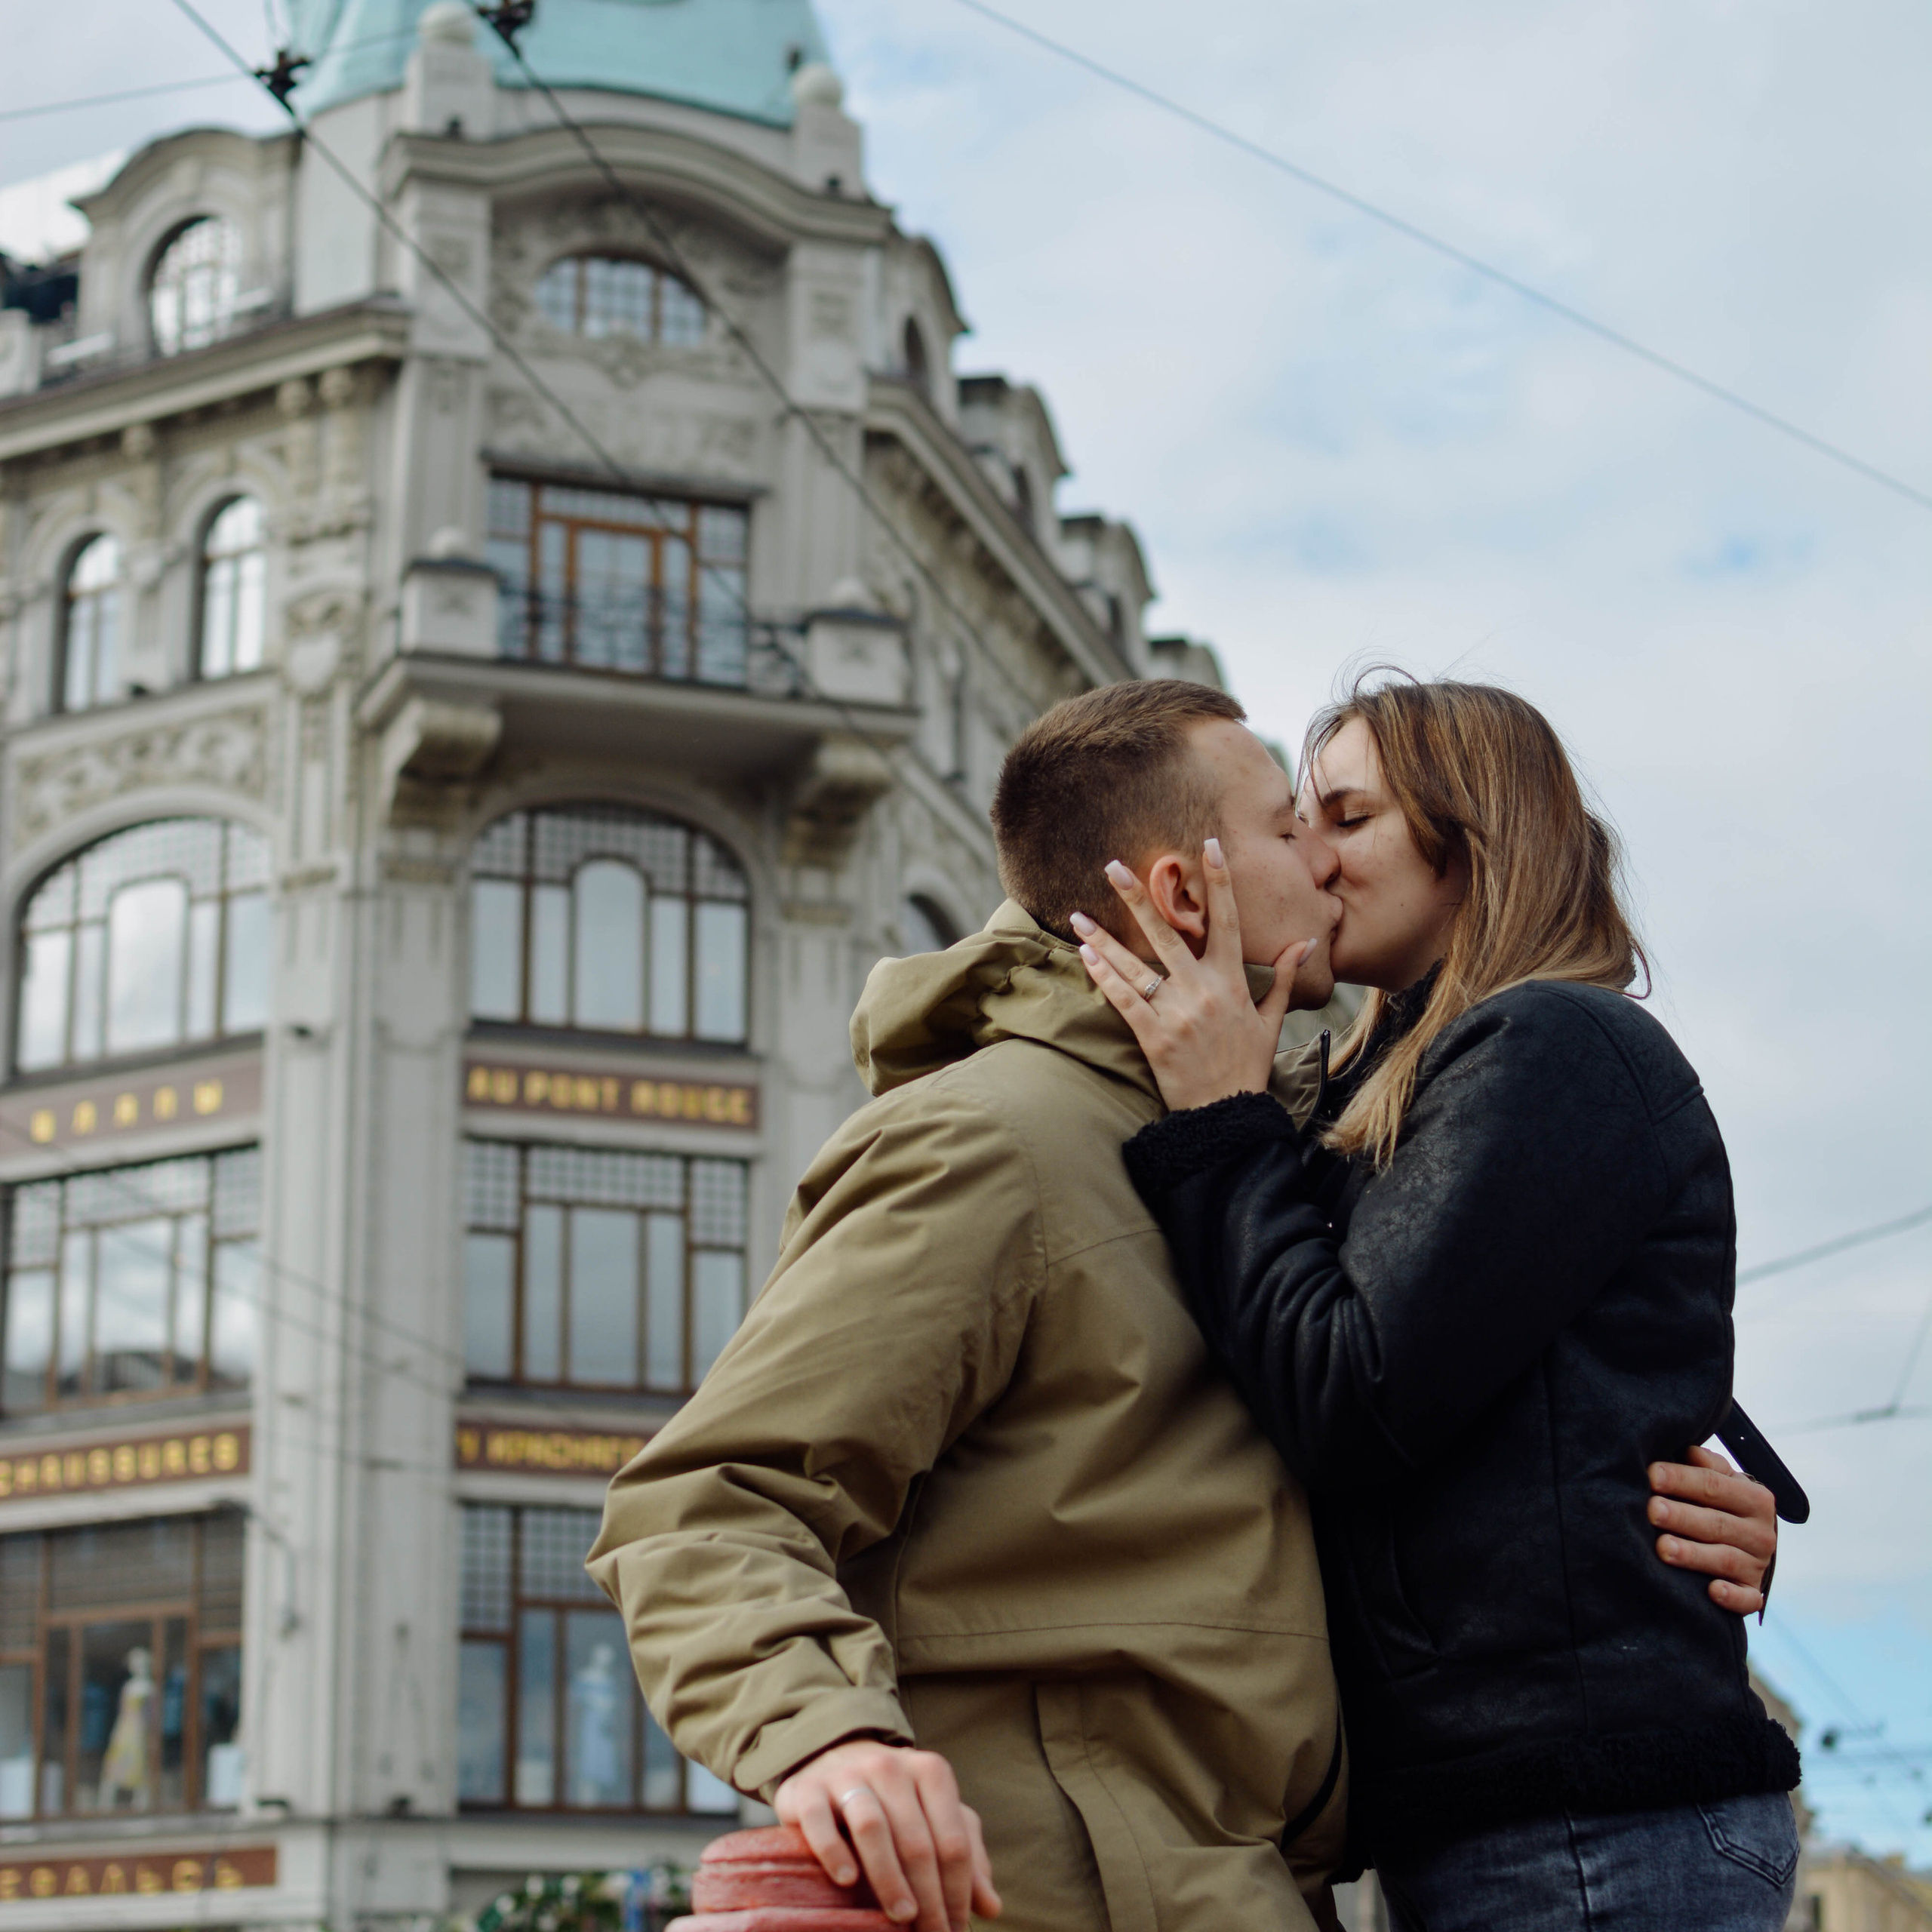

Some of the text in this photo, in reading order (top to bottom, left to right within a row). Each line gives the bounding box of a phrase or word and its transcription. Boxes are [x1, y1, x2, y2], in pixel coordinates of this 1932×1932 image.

[467, 1066, 752, 1124] AU PONT ROUGE
